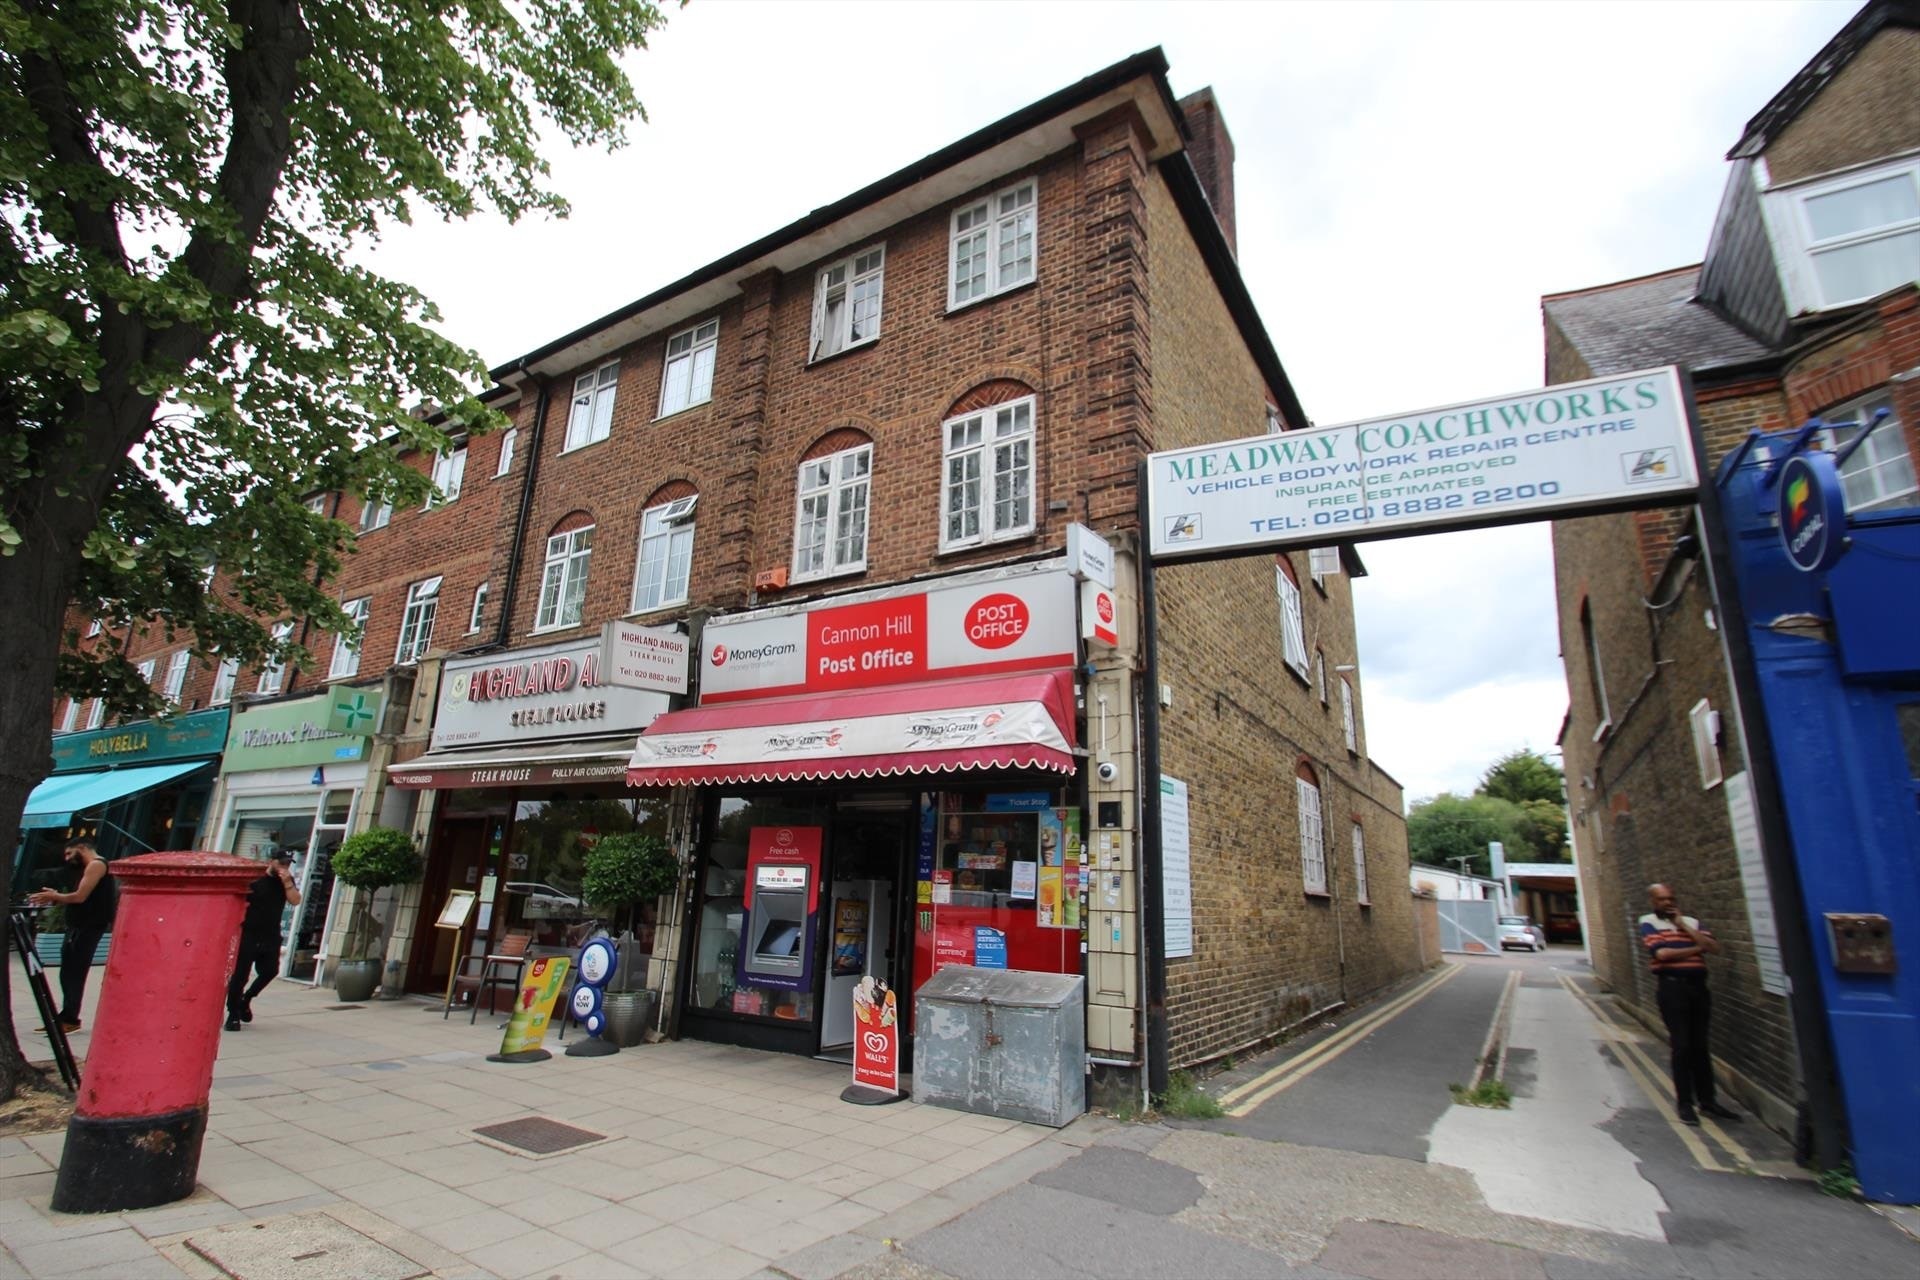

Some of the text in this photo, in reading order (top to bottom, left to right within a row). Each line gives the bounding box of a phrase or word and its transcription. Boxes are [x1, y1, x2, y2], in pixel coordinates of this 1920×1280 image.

[1168, 381, 1660, 483] MEADWAY COACHWORKS
[1187, 473, 1273, 495] VEHICLE
[1428, 436, 1519, 461] REPAIR
[1525, 418, 1636, 446] CENTRE
[1276, 455, 1517, 499] INSURANCE APPROVED
[1307, 475, 1486, 509] FREE ESTIMATES
[1250, 480, 1560, 534] TEL: 020 8882 2200
[977, 603, 1018, 623] POST
[821, 614, 913, 645] Cannon Hill
[970, 619, 1023, 640] OFFICE
[621, 631, 683, 653] HIGHLAND ANGUS
[729, 643, 796, 661] MoneyGram
[629, 650, 674, 665] STEAK HOUSE
[820, 648, 914, 675] Post Office
[468, 657, 574, 702] HIGHLAND
[620, 667, 681, 684] Tel: 020 8882 4897
[511, 700, 606, 727] STEAK HOUSE
[89, 731, 148, 754] HOLYBELLA
[243, 727, 296, 748] Walbrook
[471, 768, 531, 783] STEAK HOUSE
[552, 764, 629, 778] FULLY AIR CONDITIONE
[769, 846, 799, 855] Free cash
